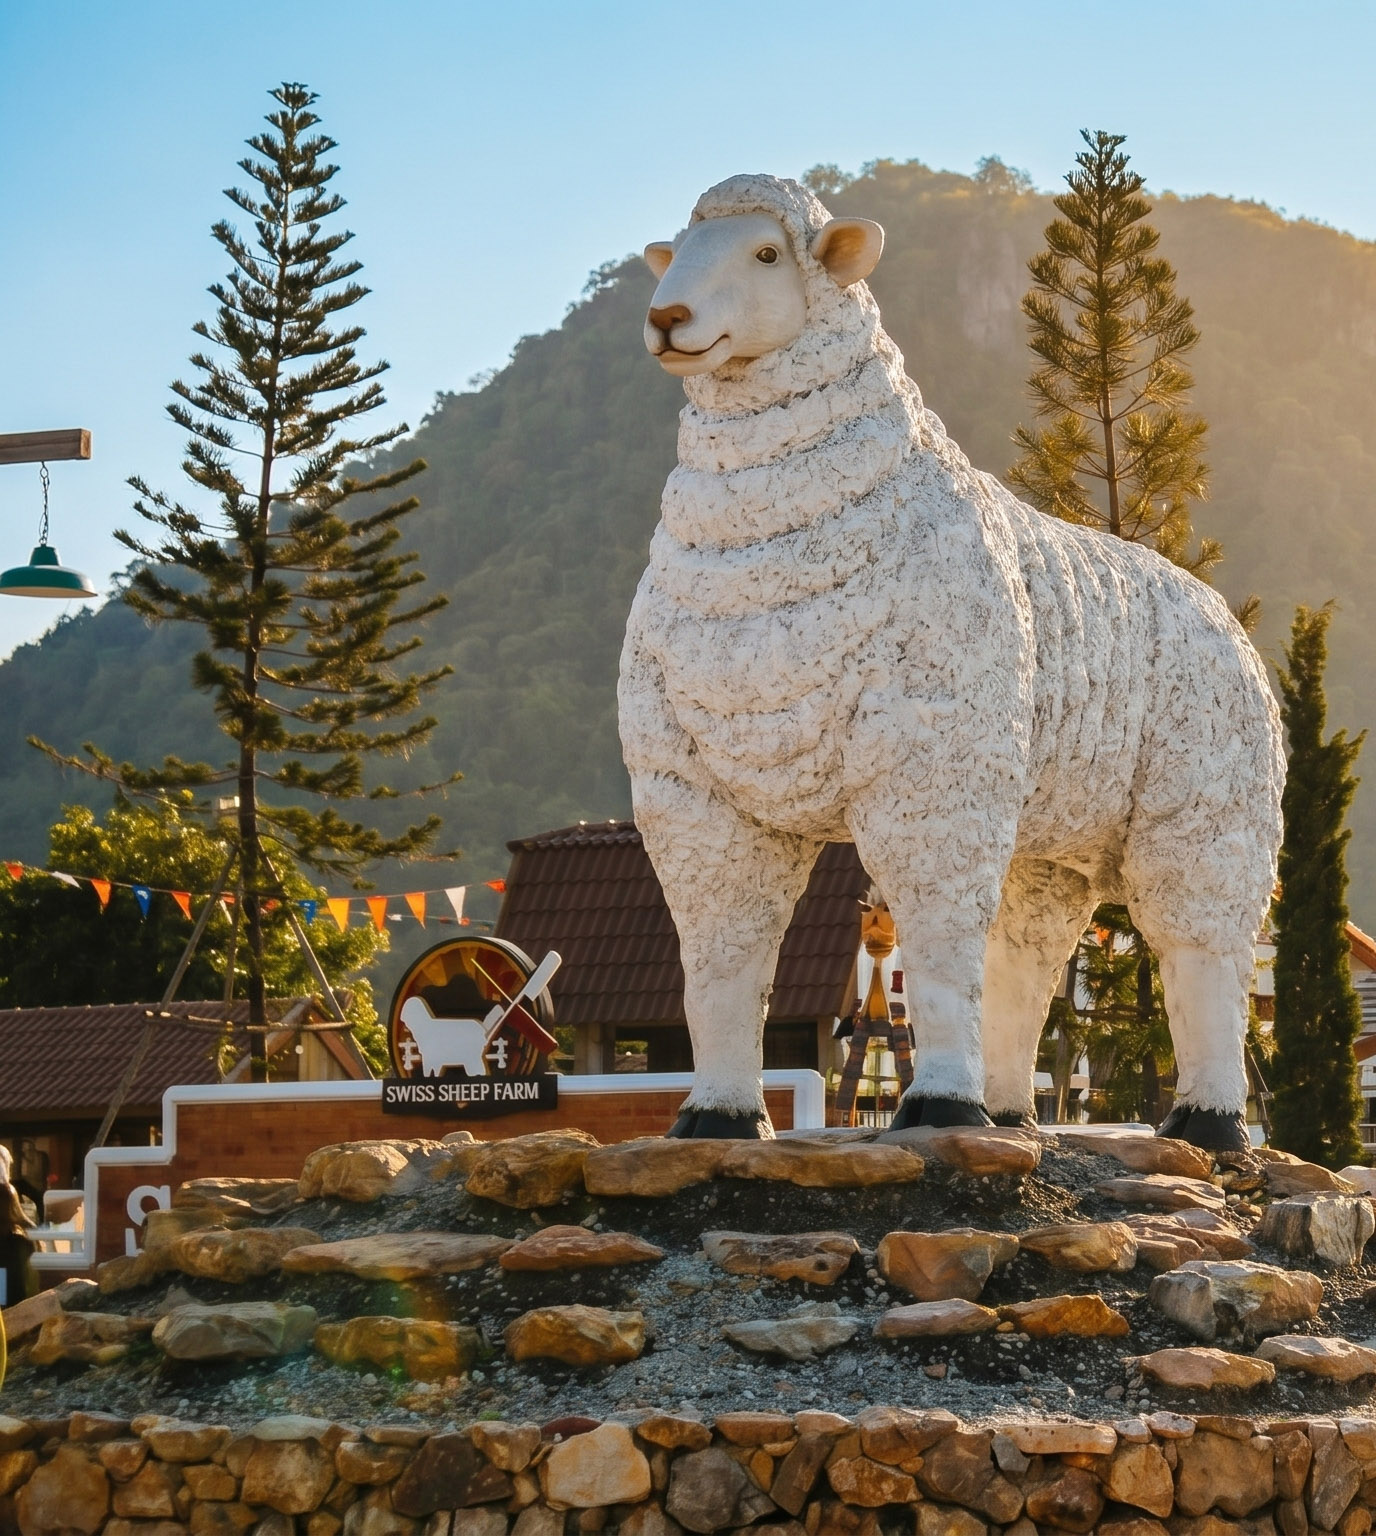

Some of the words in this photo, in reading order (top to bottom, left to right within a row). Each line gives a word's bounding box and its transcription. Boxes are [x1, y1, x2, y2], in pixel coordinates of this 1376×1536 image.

[386, 1085, 435, 1103] SWISS
[438, 1083, 490, 1102] SHEEP
[493, 1082, 539, 1100] FARM
